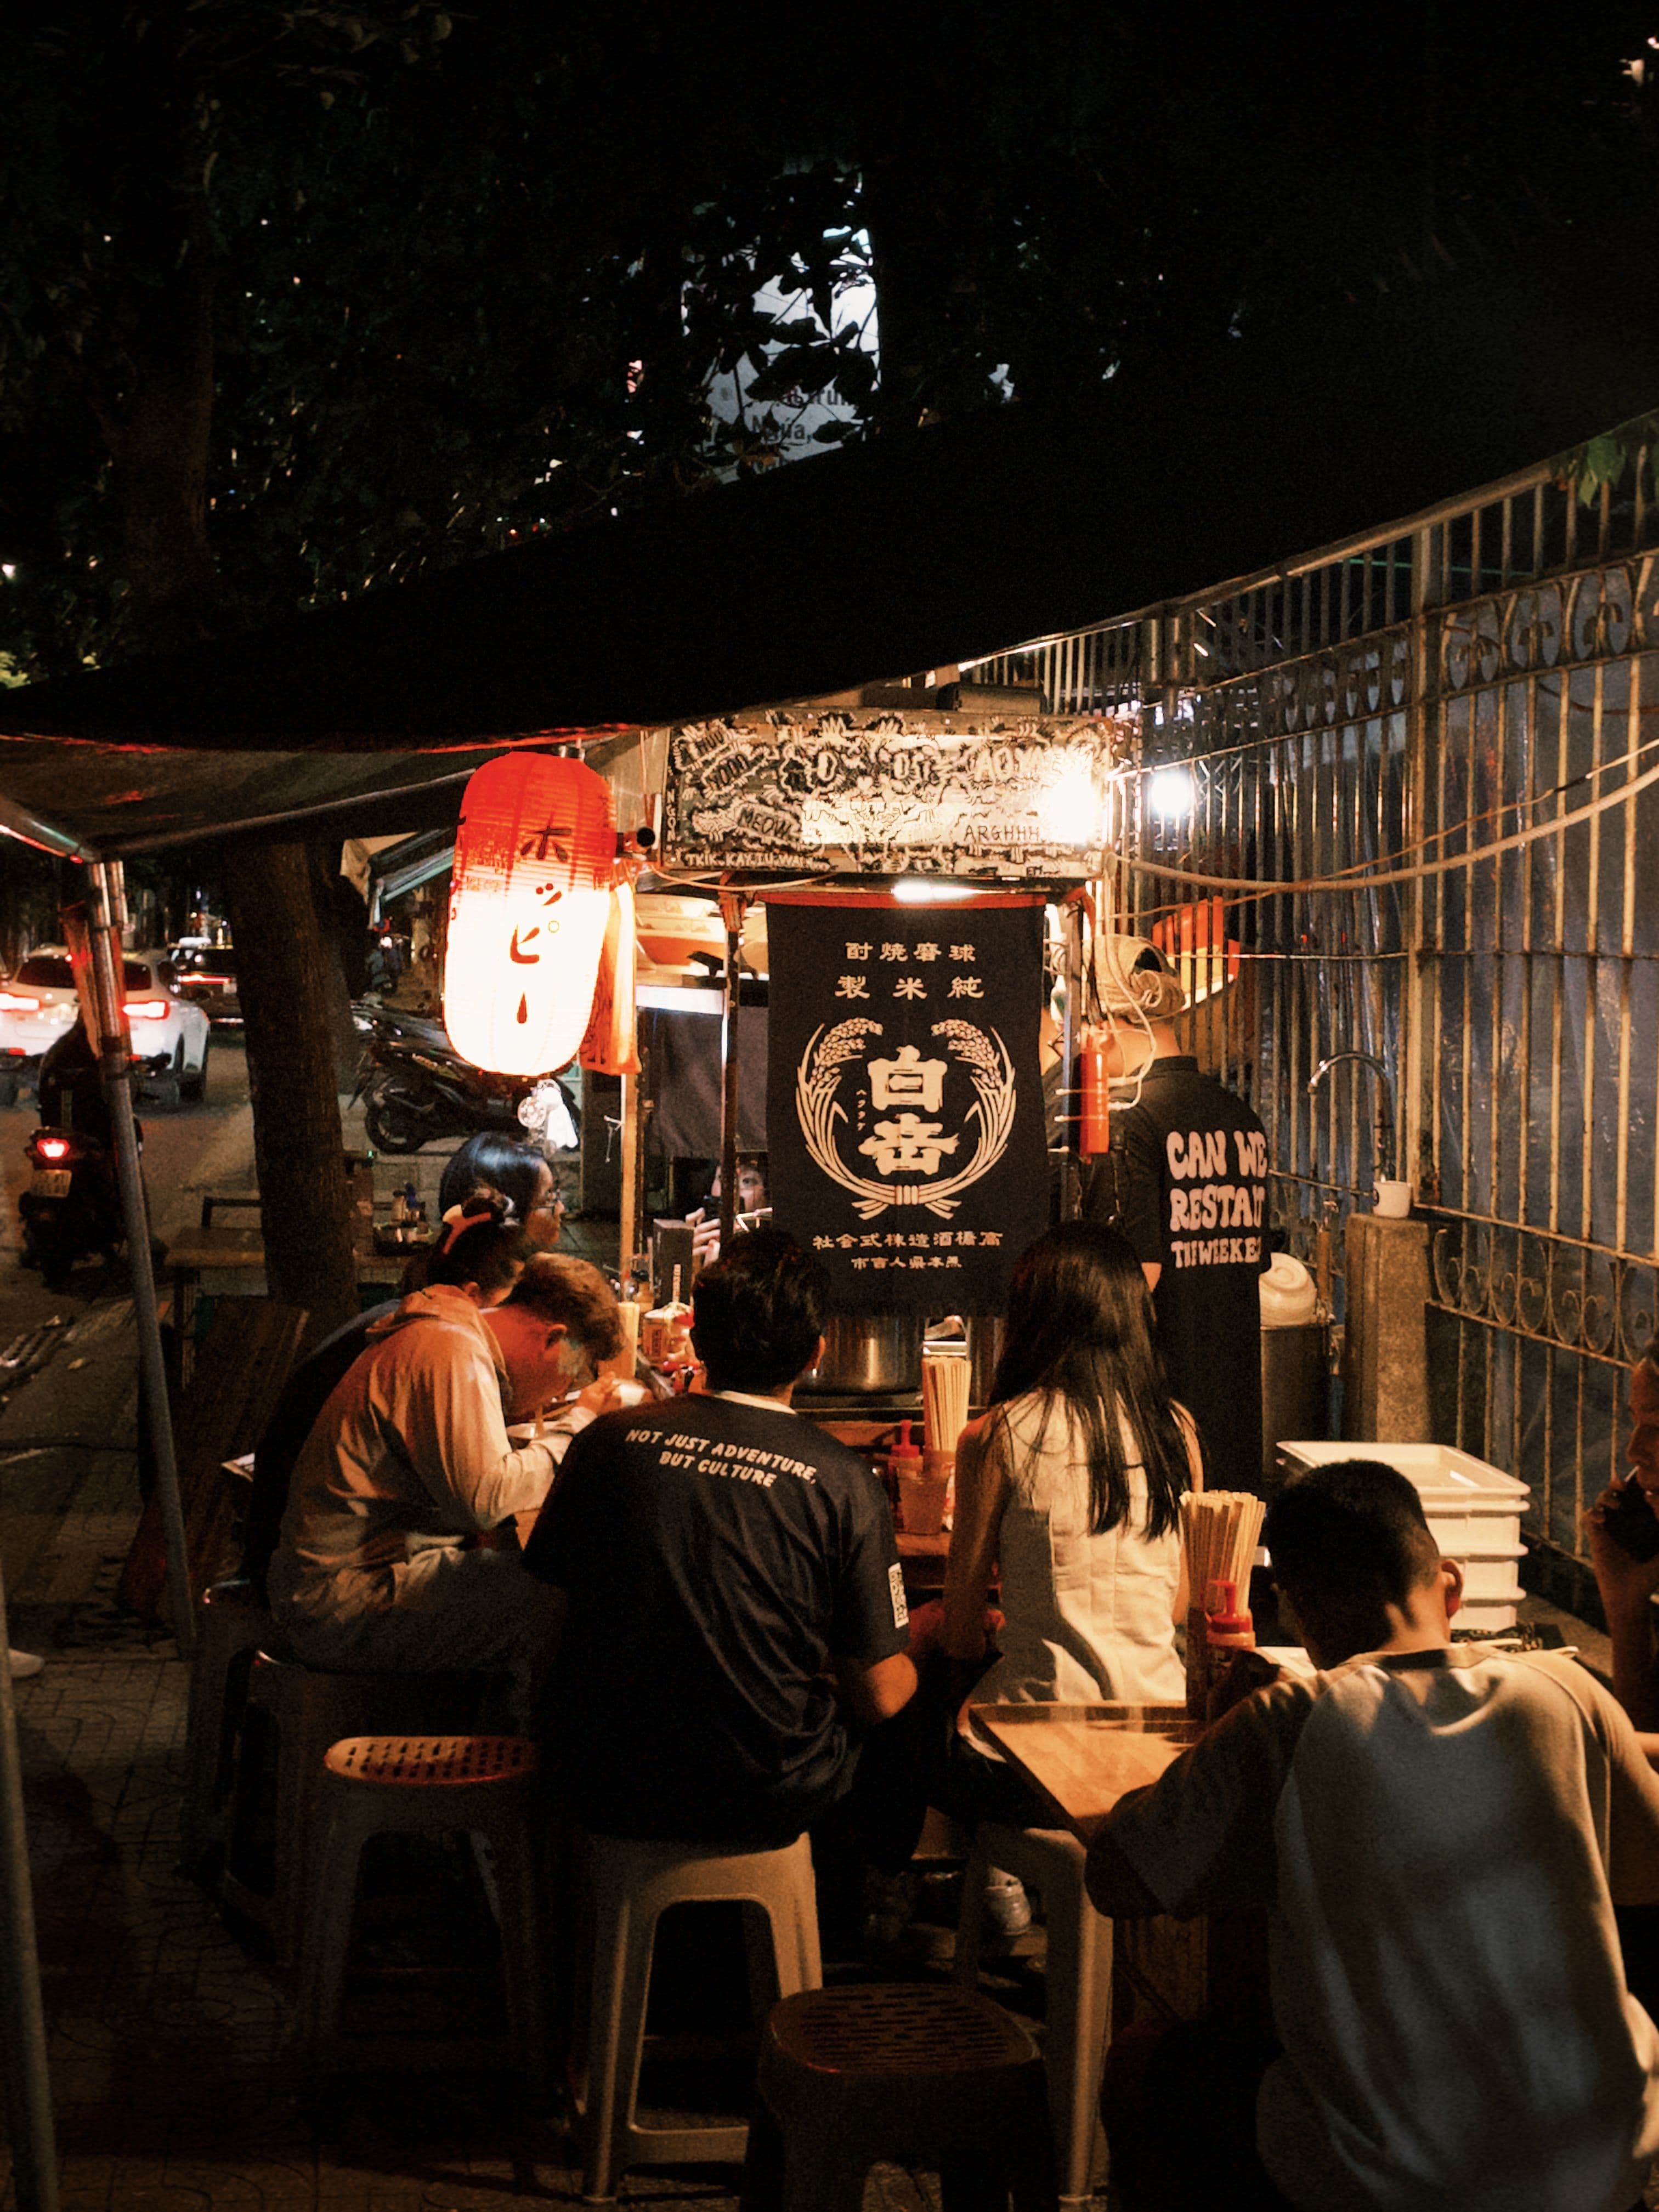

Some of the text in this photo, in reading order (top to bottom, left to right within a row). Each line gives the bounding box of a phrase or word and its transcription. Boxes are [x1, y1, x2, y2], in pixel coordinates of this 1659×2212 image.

[1166, 1130, 1267, 1180] CAN WE
[625, 1429, 818, 1485] NOT JUST ADVENTURE,
[659, 1451, 778, 1488] BUT CULTURE
